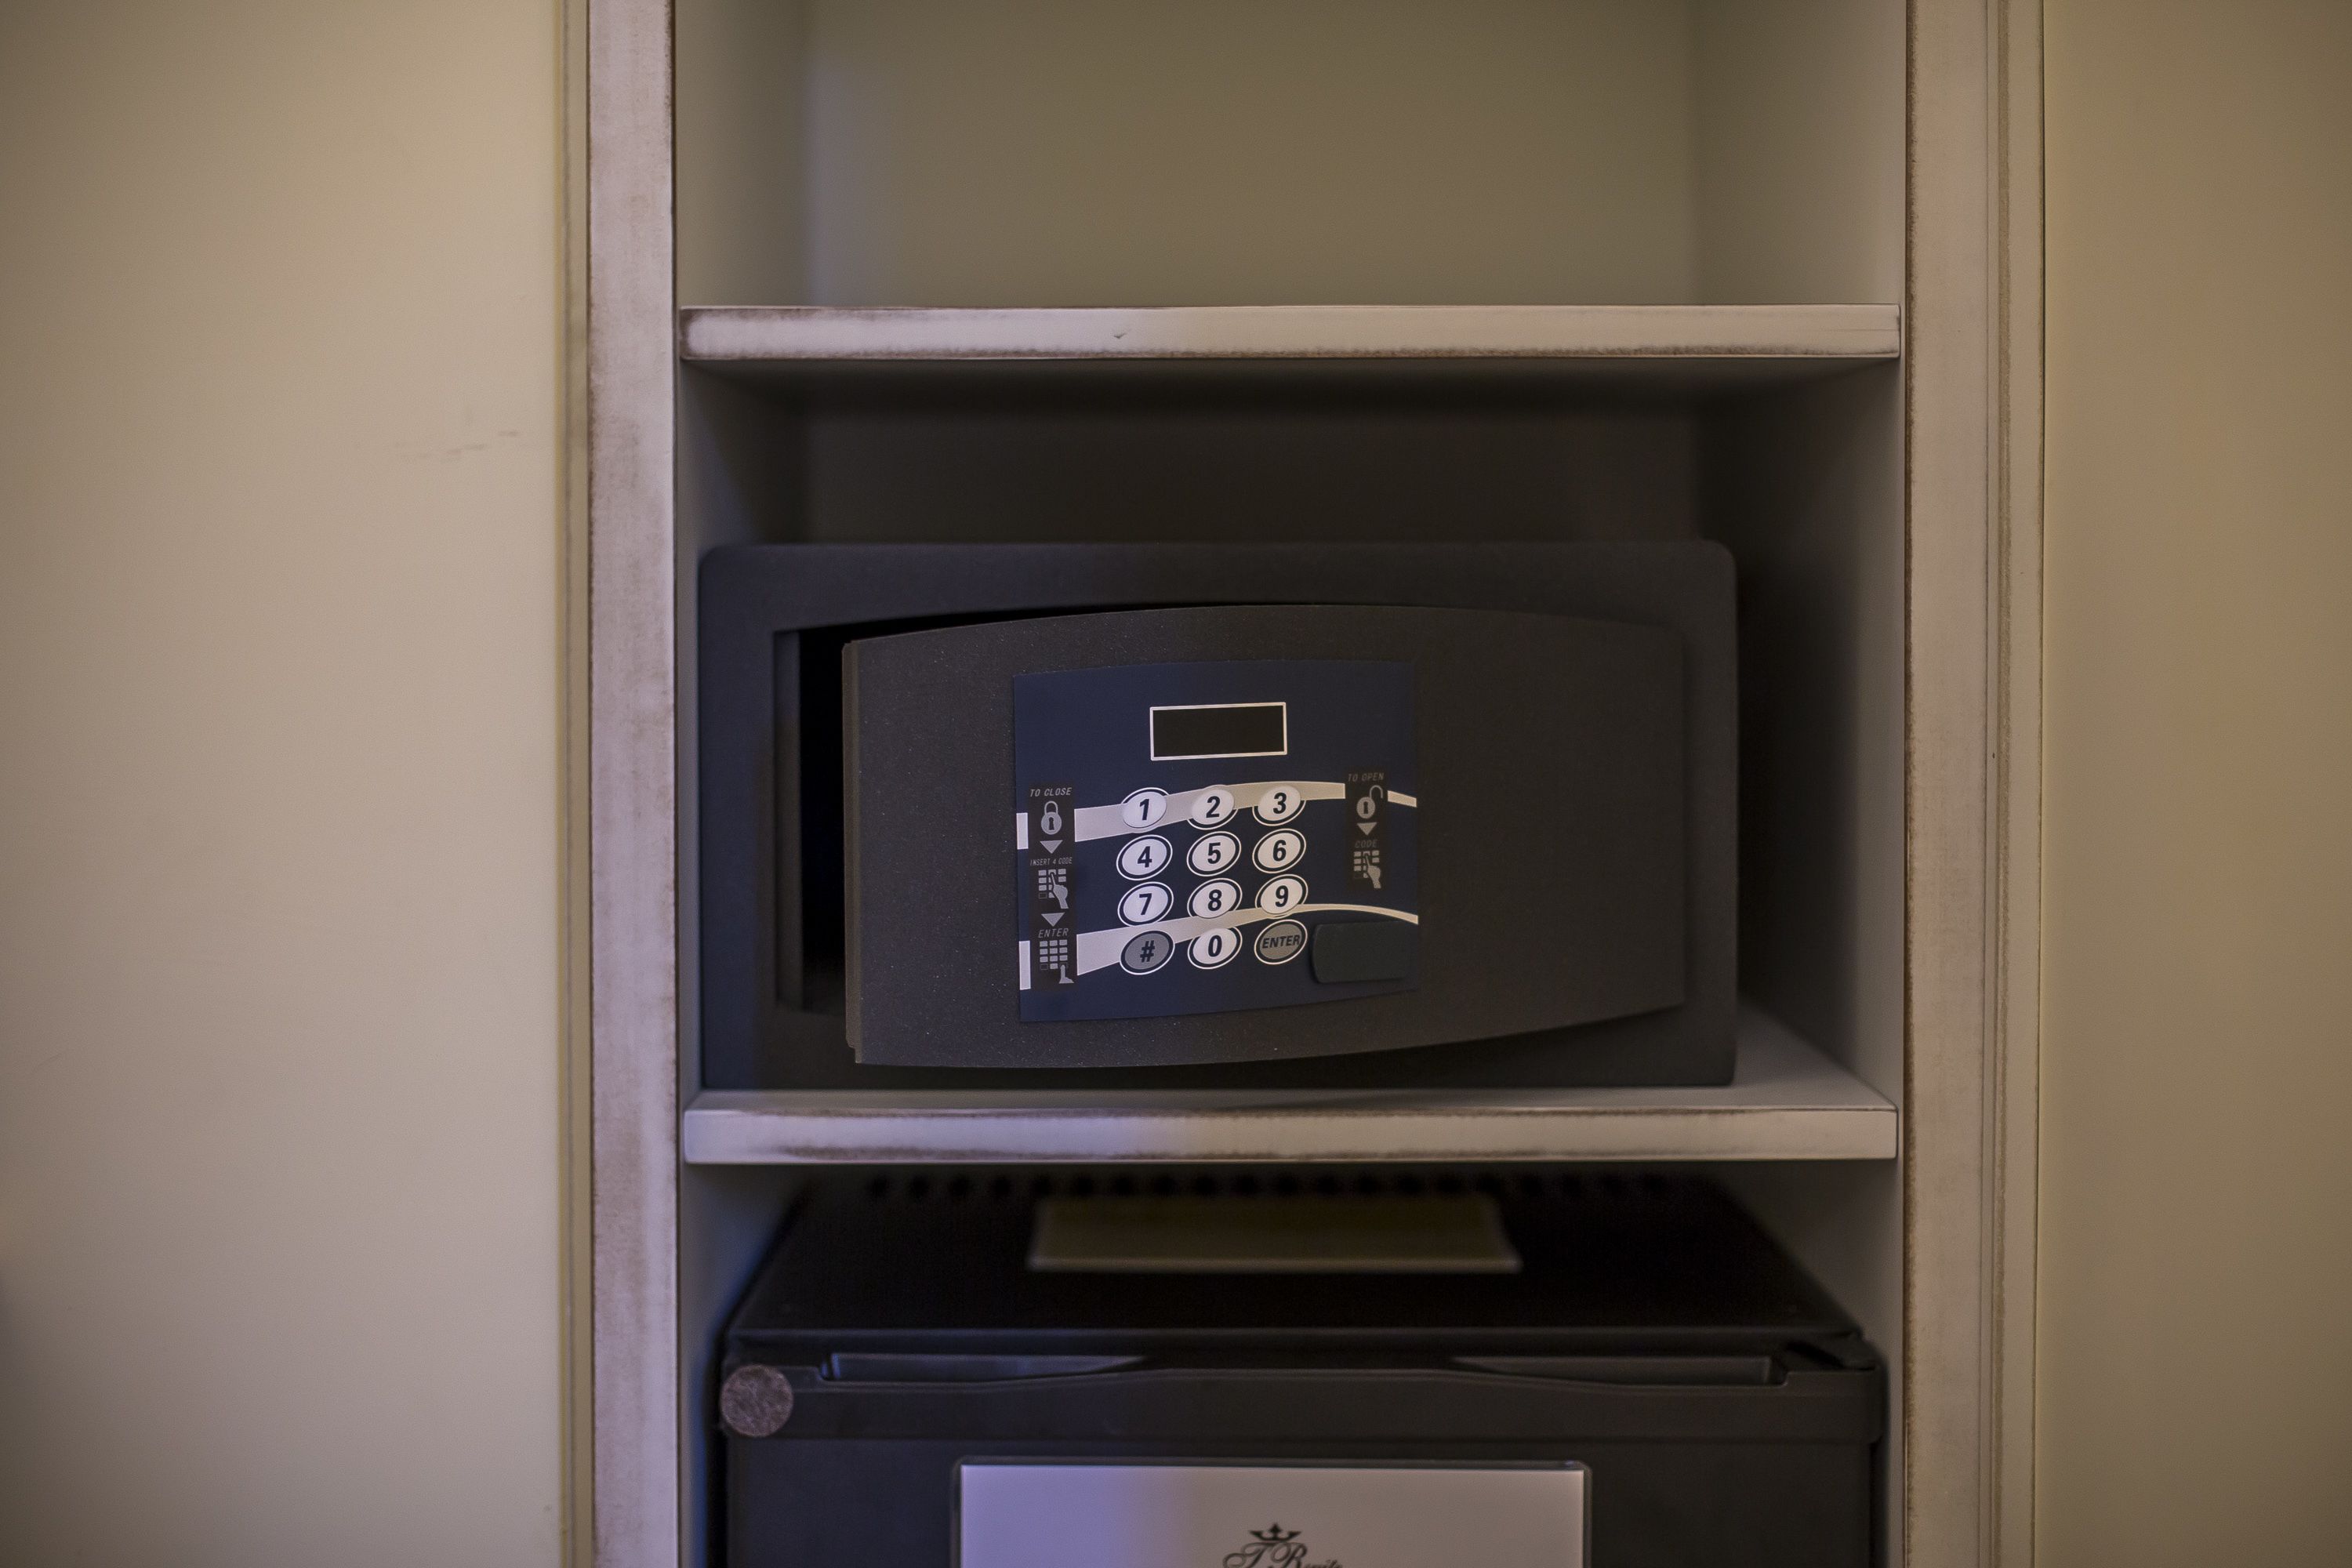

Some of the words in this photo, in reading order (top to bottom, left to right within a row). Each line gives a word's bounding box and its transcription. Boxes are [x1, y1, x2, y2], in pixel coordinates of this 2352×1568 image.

[1029, 789, 1040, 797] TO
[1044, 787, 1073, 797] CLOSE
[1139, 798, 1150, 821] 1
[1206, 796, 1221, 818] 2
[1272, 792, 1287, 815] 3
[1137, 846, 1152, 868] 4
[1207, 842, 1221, 865] 5
[1272, 839, 1287, 862] 6
[1138, 893, 1152, 916] 7
[1207, 889, 1222, 912] 8
[1275, 885, 1289, 908] 9
[1038, 927, 1069, 938] ENTER
[1207, 935, 1222, 957] 0
[1261, 934, 1301, 949] ENTER
